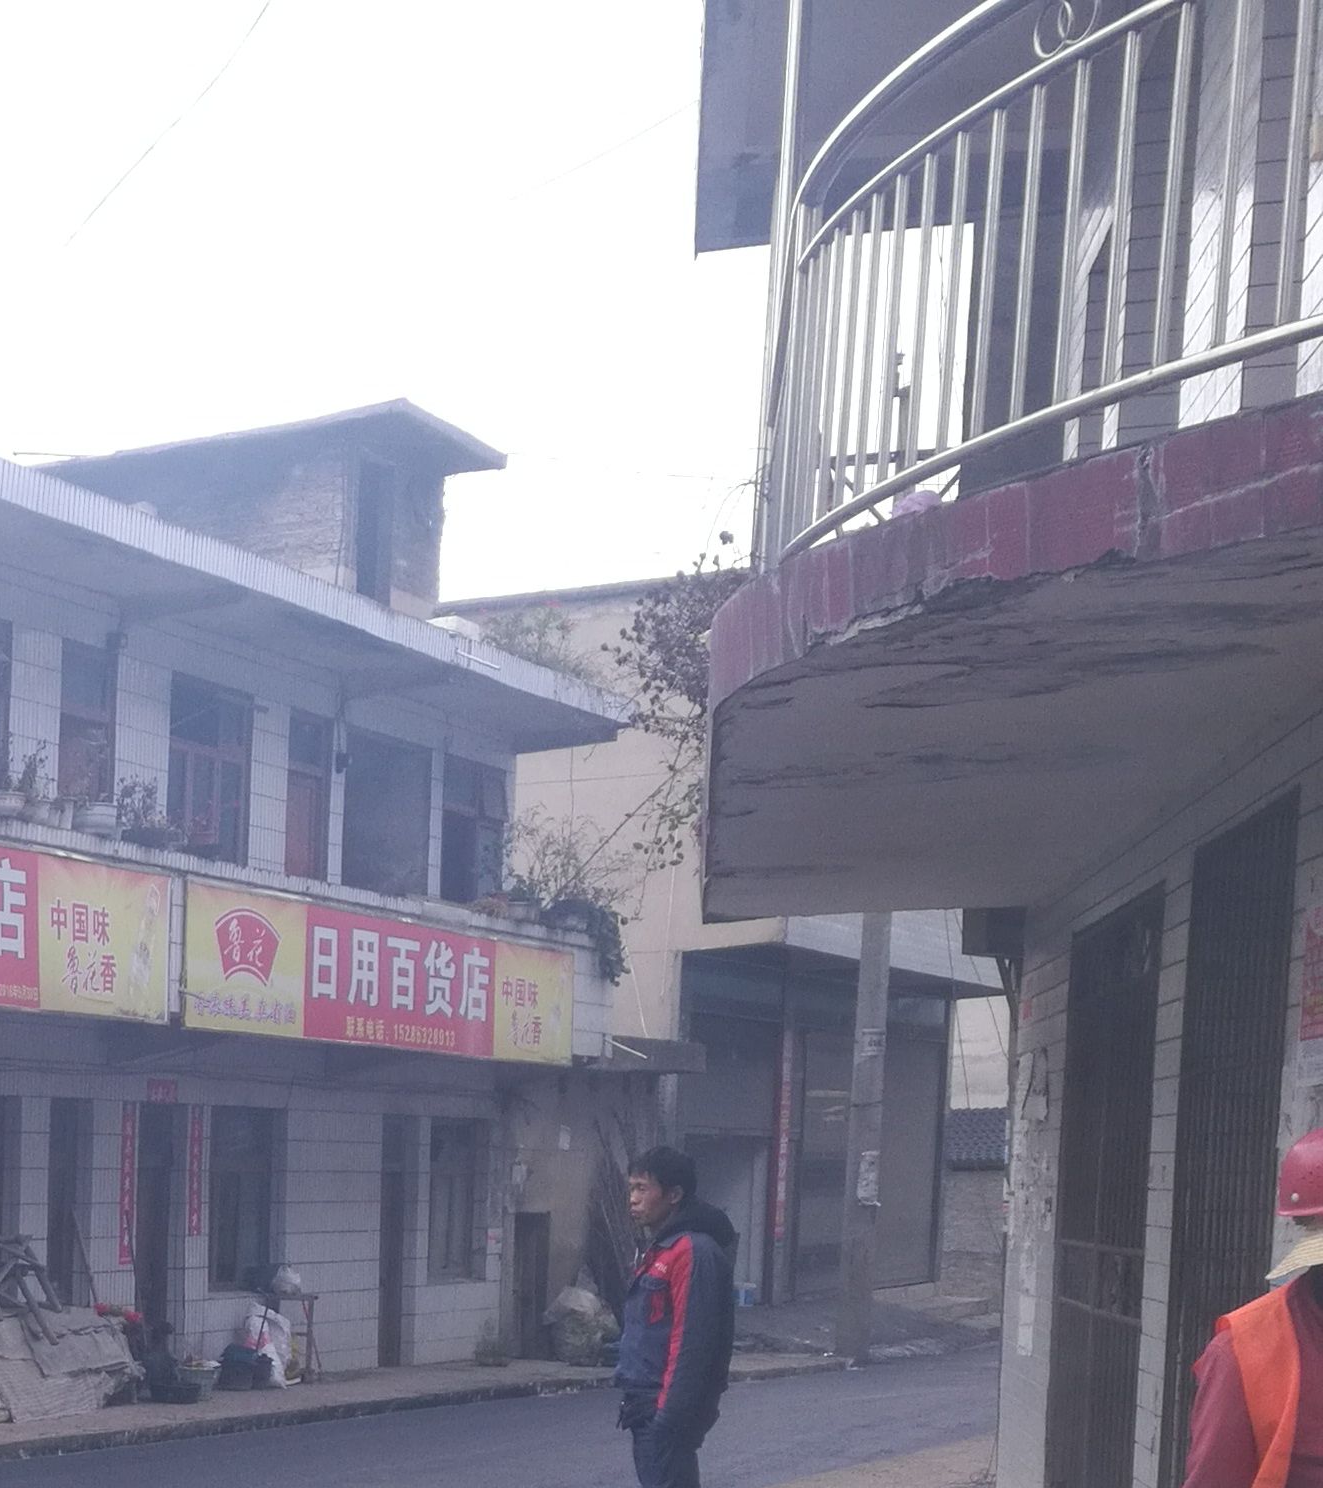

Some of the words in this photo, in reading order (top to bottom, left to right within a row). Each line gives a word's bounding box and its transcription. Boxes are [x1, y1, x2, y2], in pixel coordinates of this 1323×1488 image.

[50, 899, 110, 946] 中国味
[311, 925, 490, 1022] 日用百货店
